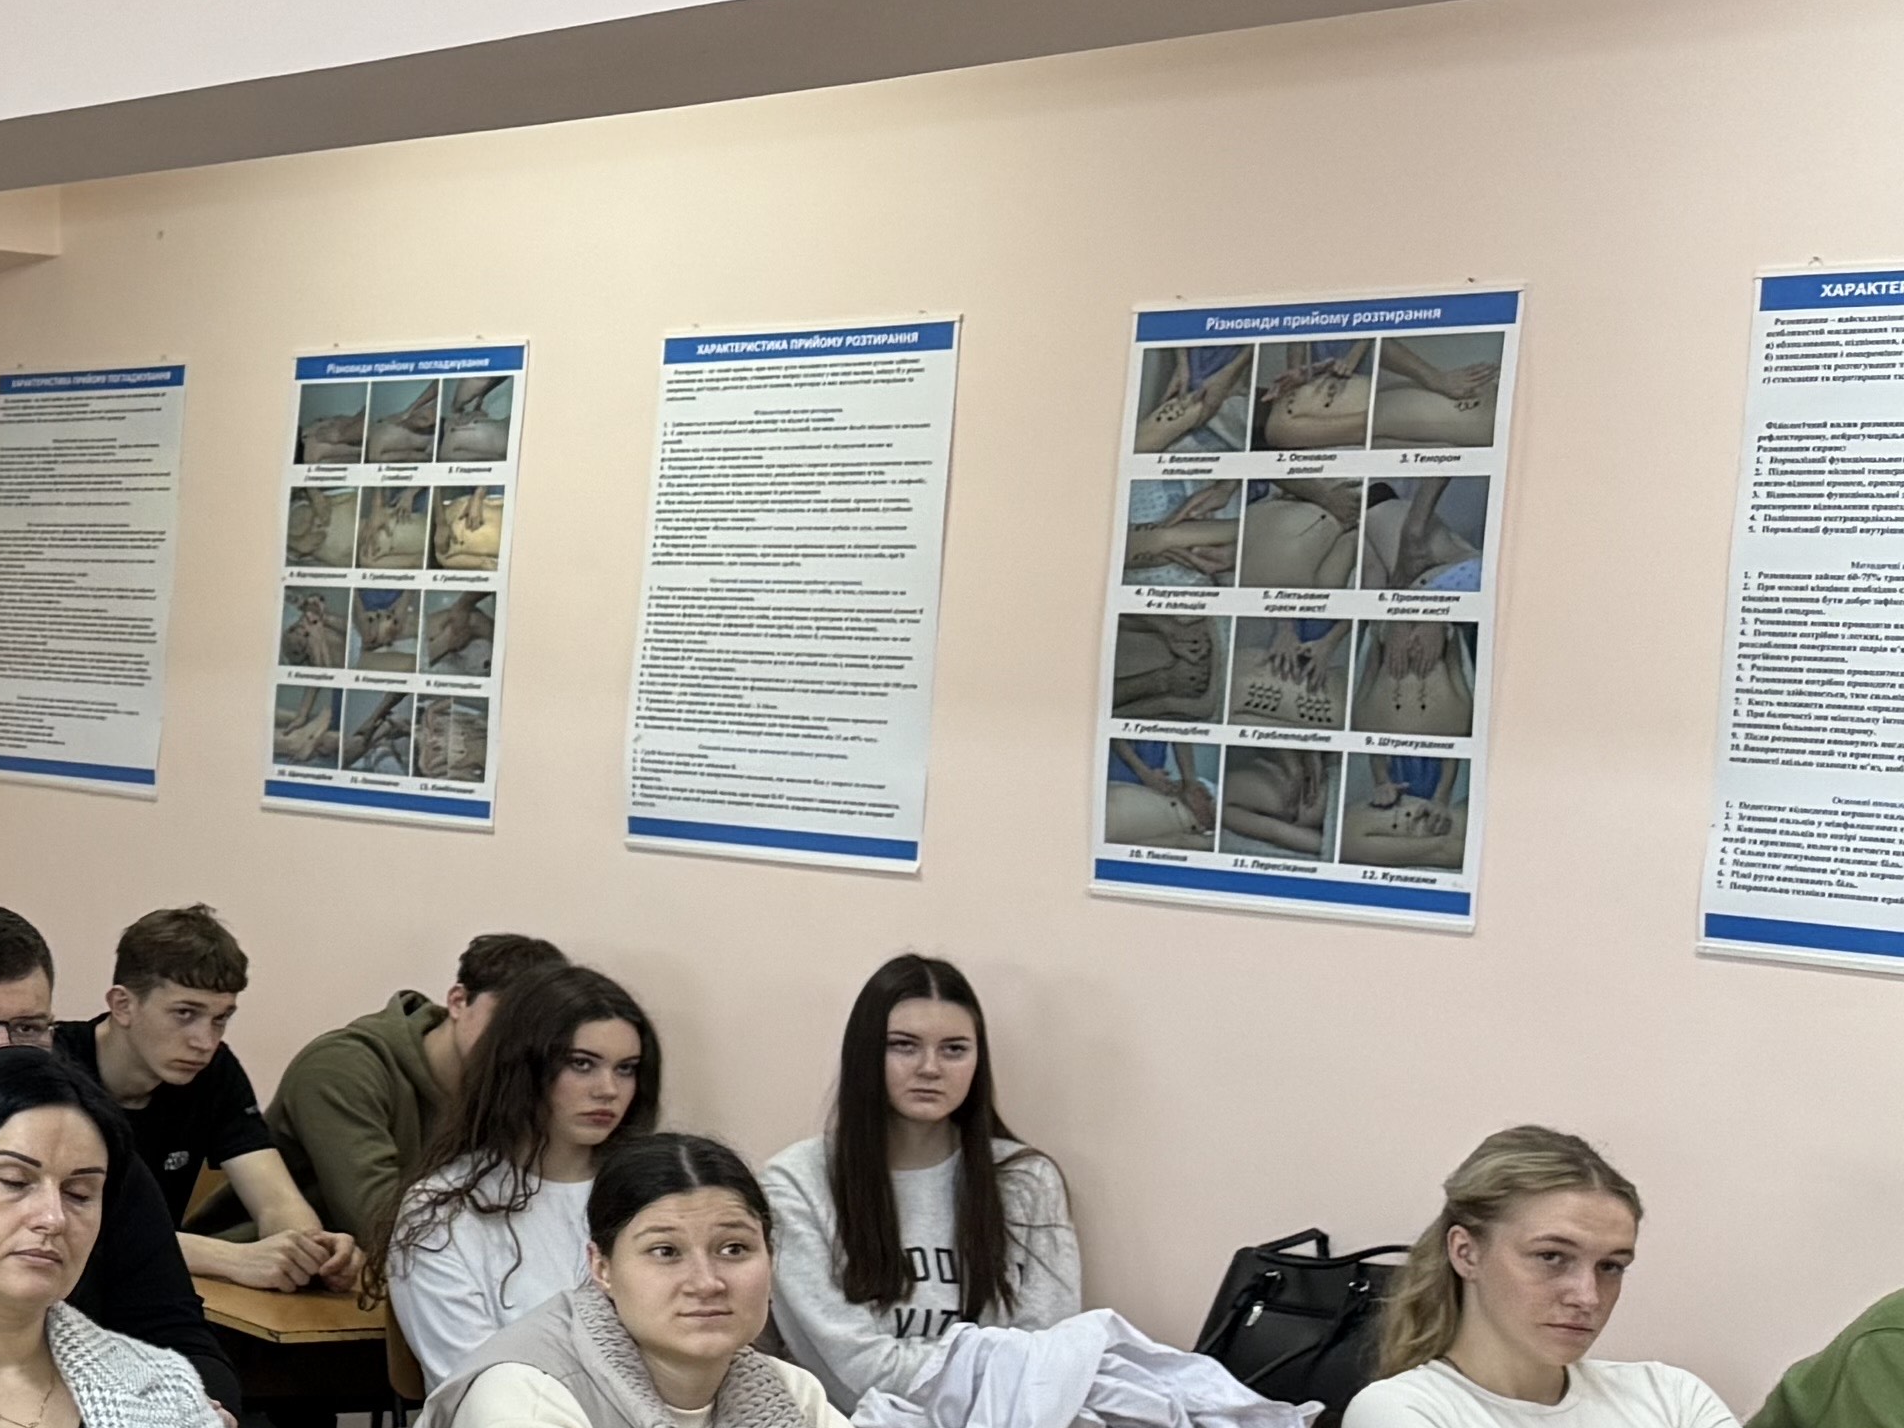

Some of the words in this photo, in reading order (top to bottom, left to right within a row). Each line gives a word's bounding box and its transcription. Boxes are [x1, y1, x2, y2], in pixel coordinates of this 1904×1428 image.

[1206, 317, 1279, 331] Різновиди
[1283, 311, 1350, 328] прийому
[1353, 307, 1442, 326] розтирання
[697, 342, 788, 355] ХАРАКТЕРИСТИКА
[790, 337, 843, 351] ПРИЙОМУ
[845, 332, 919, 347] РОЗТИРАННЯ
